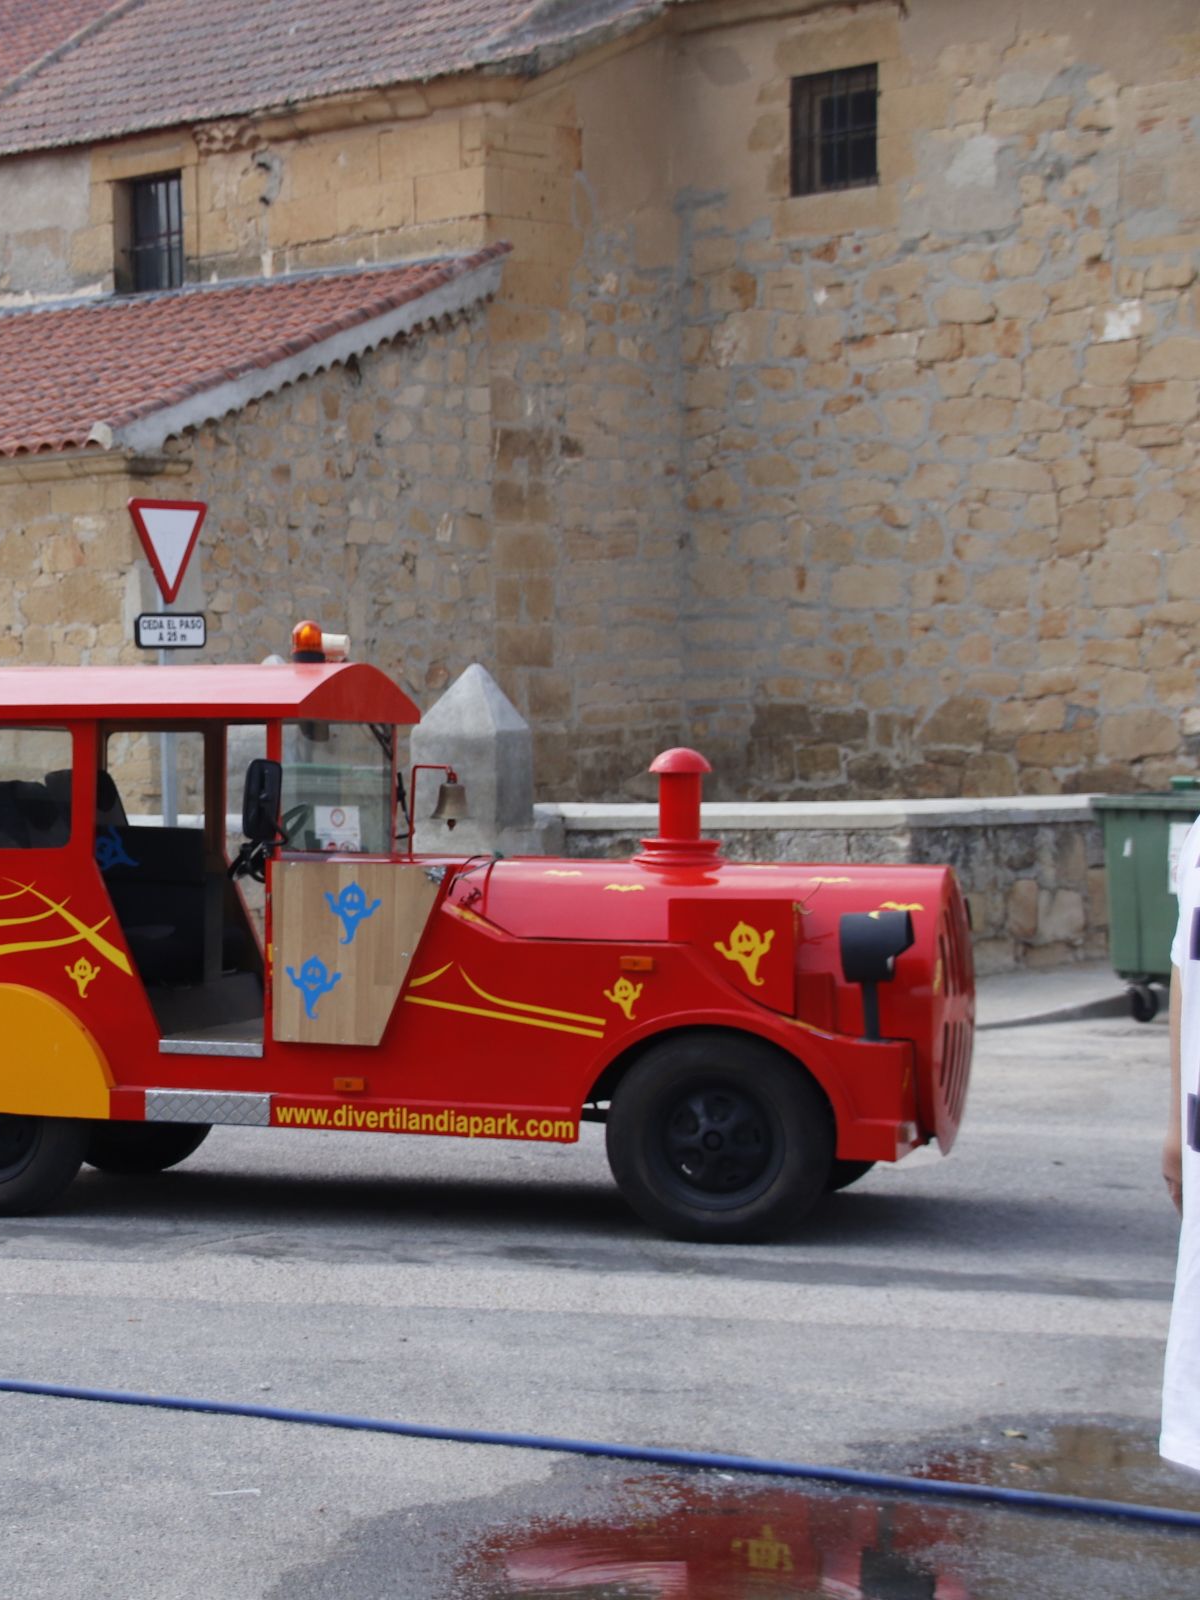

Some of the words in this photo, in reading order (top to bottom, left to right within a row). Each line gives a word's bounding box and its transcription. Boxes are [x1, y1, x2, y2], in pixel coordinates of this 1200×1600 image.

[141, 619, 164, 630] CEDA
[167, 619, 177, 630] EL
[180, 619, 202, 629] PASO
[158, 632, 164, 642] A
[167, 632, 177, 642] 25
[276, 1104, 575, 1139] www.divertilandiapark.com
